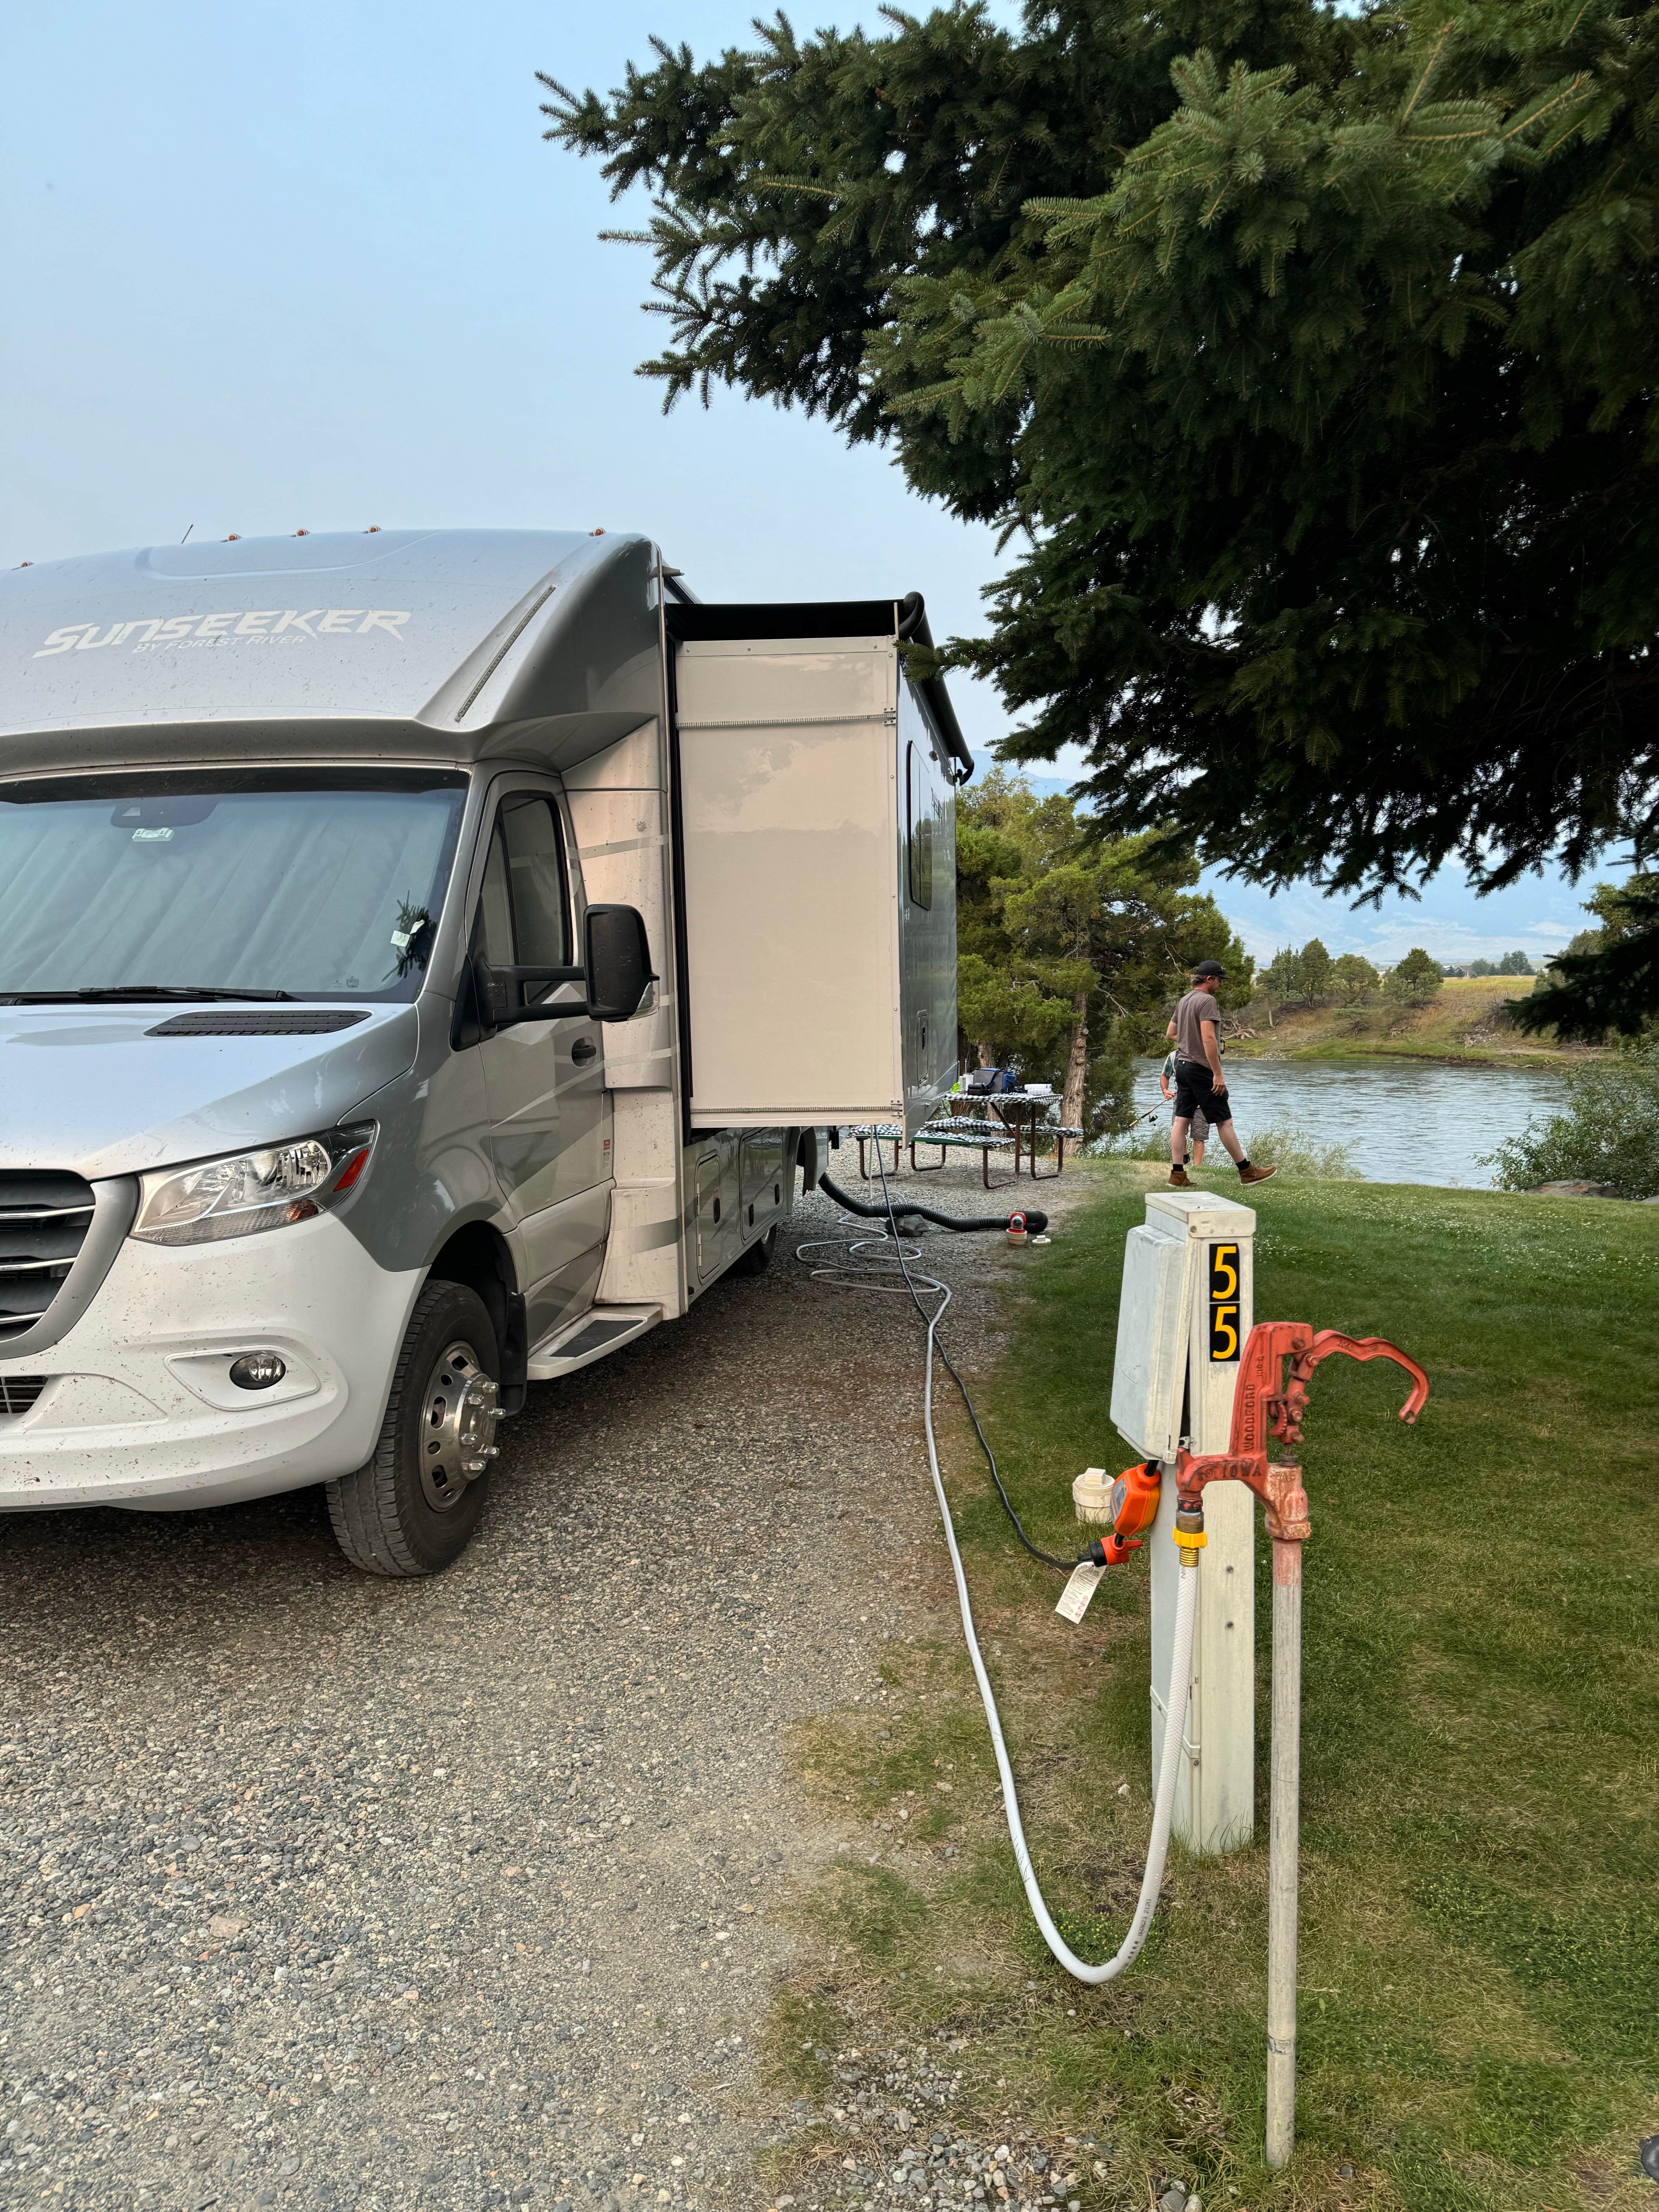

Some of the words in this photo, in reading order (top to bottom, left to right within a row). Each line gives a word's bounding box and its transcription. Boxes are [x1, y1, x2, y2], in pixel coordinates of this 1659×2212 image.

[32, 610, 411, 658] SUNSEEKER
[165, 637, 243, 650] FOREST
[245, 635, 306, 644] RIVER
[1243, 1384, 1255, 1451] WOODFORD
[1223, 1461, 1261, 1477] IOWA
